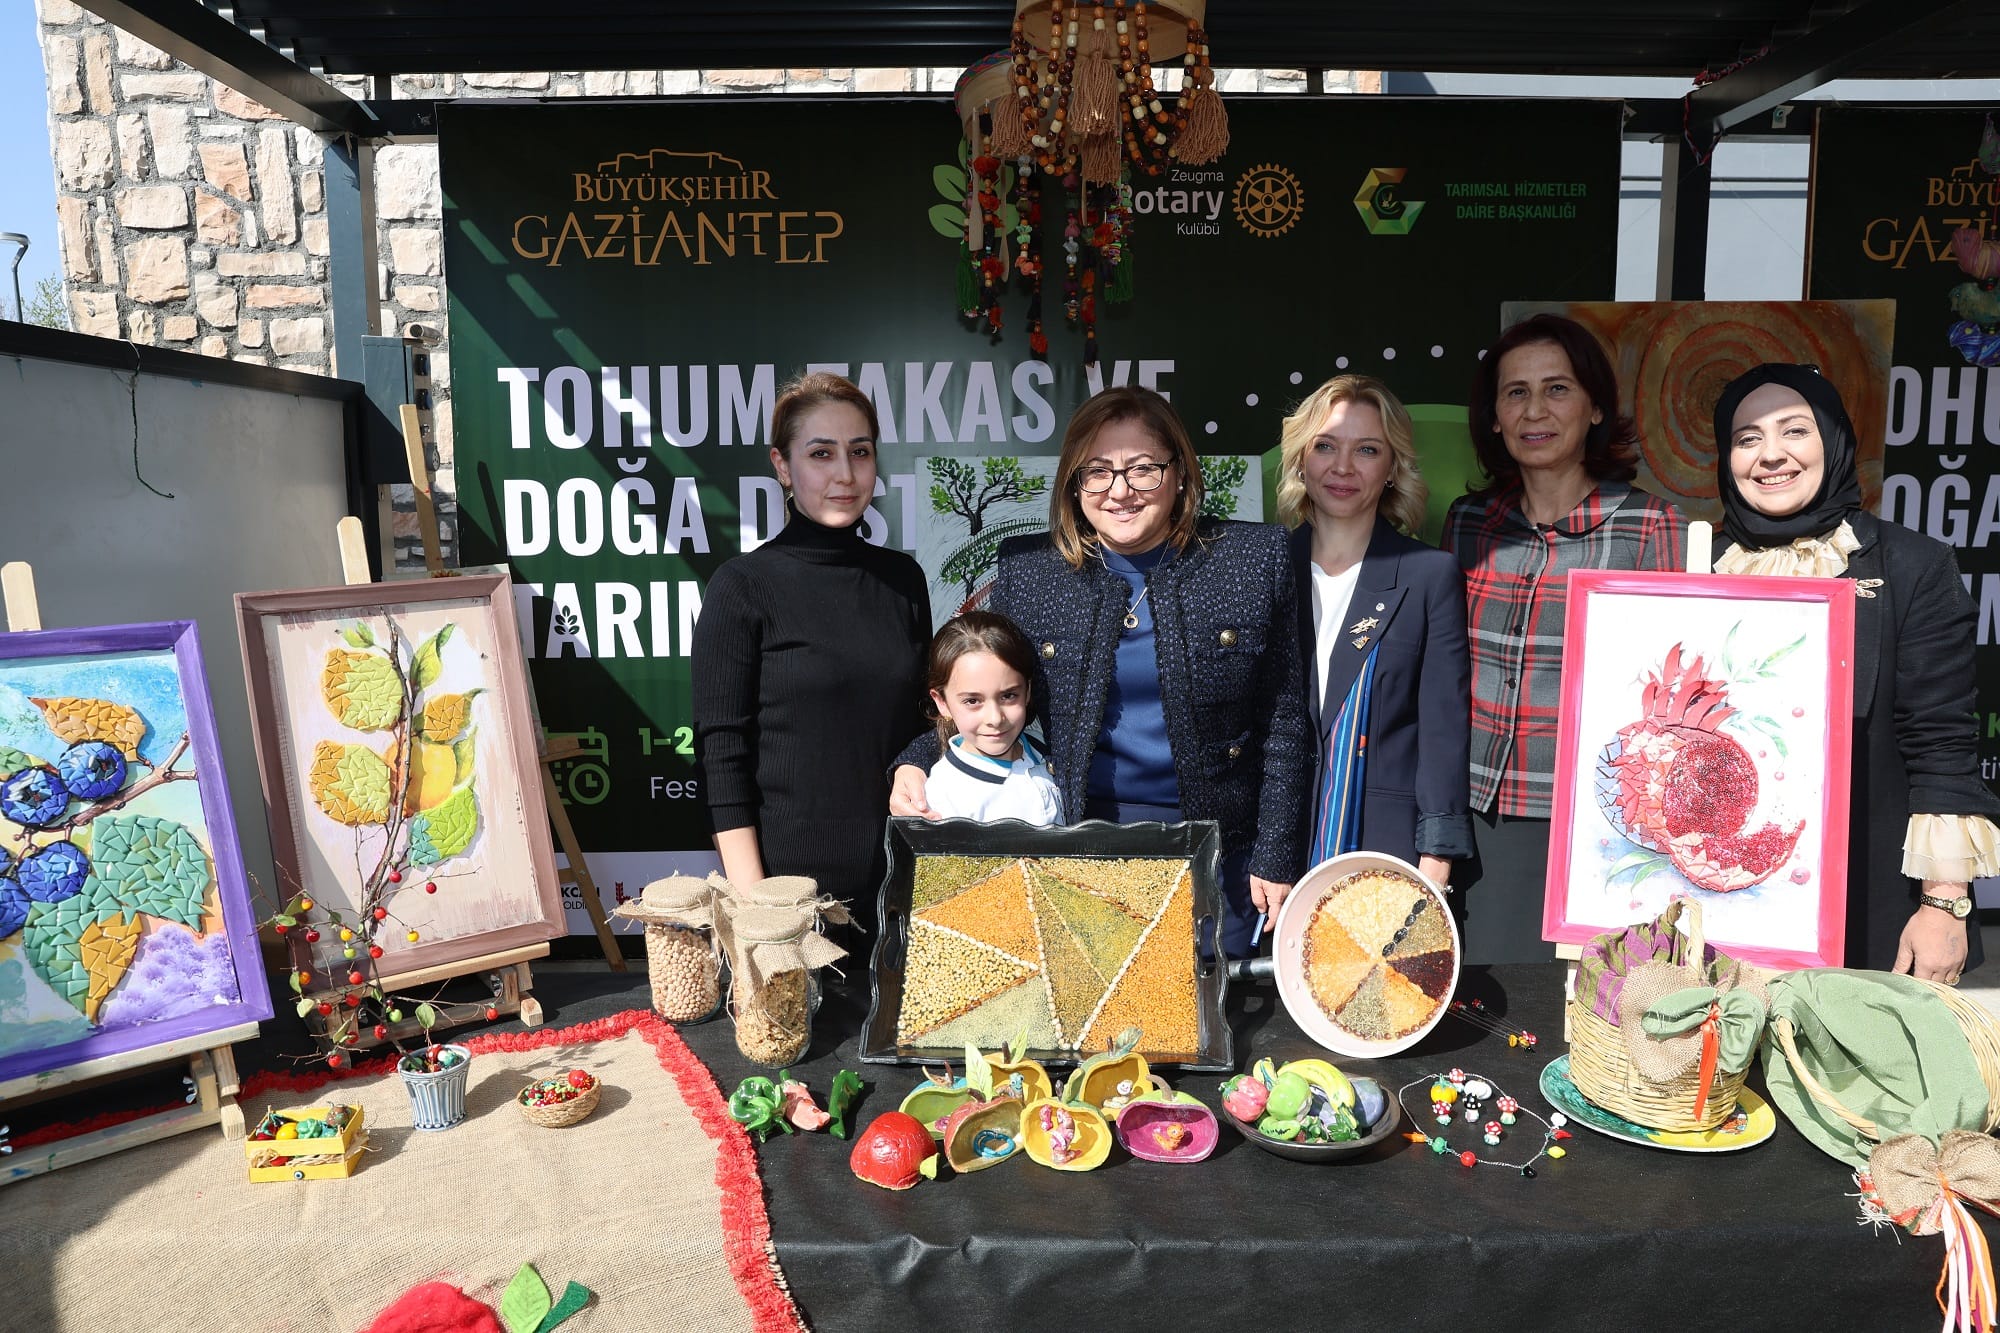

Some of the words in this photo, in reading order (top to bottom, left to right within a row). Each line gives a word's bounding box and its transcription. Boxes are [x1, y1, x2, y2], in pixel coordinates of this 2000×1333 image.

[572, 170, 779, 207] BÜYÜKŞEHİR
[1171, 169, 1224, 184] Zeugma
[1444, 183, 1511, 197] TARIMSAL
[1515, 180, 1587, 197] HİZMETLER
[1457, 202, 1495, 219] DAİRE
[1498, 202, 1576, 221] BAŞKANLIĞI
[511, 206, 844, 267] GAZİANTEP
[1177, 222, 1220, 236] Kulübü
[497, 363, 775, 450] TOHUM
[503, 457, 711, 557] DOĞA
